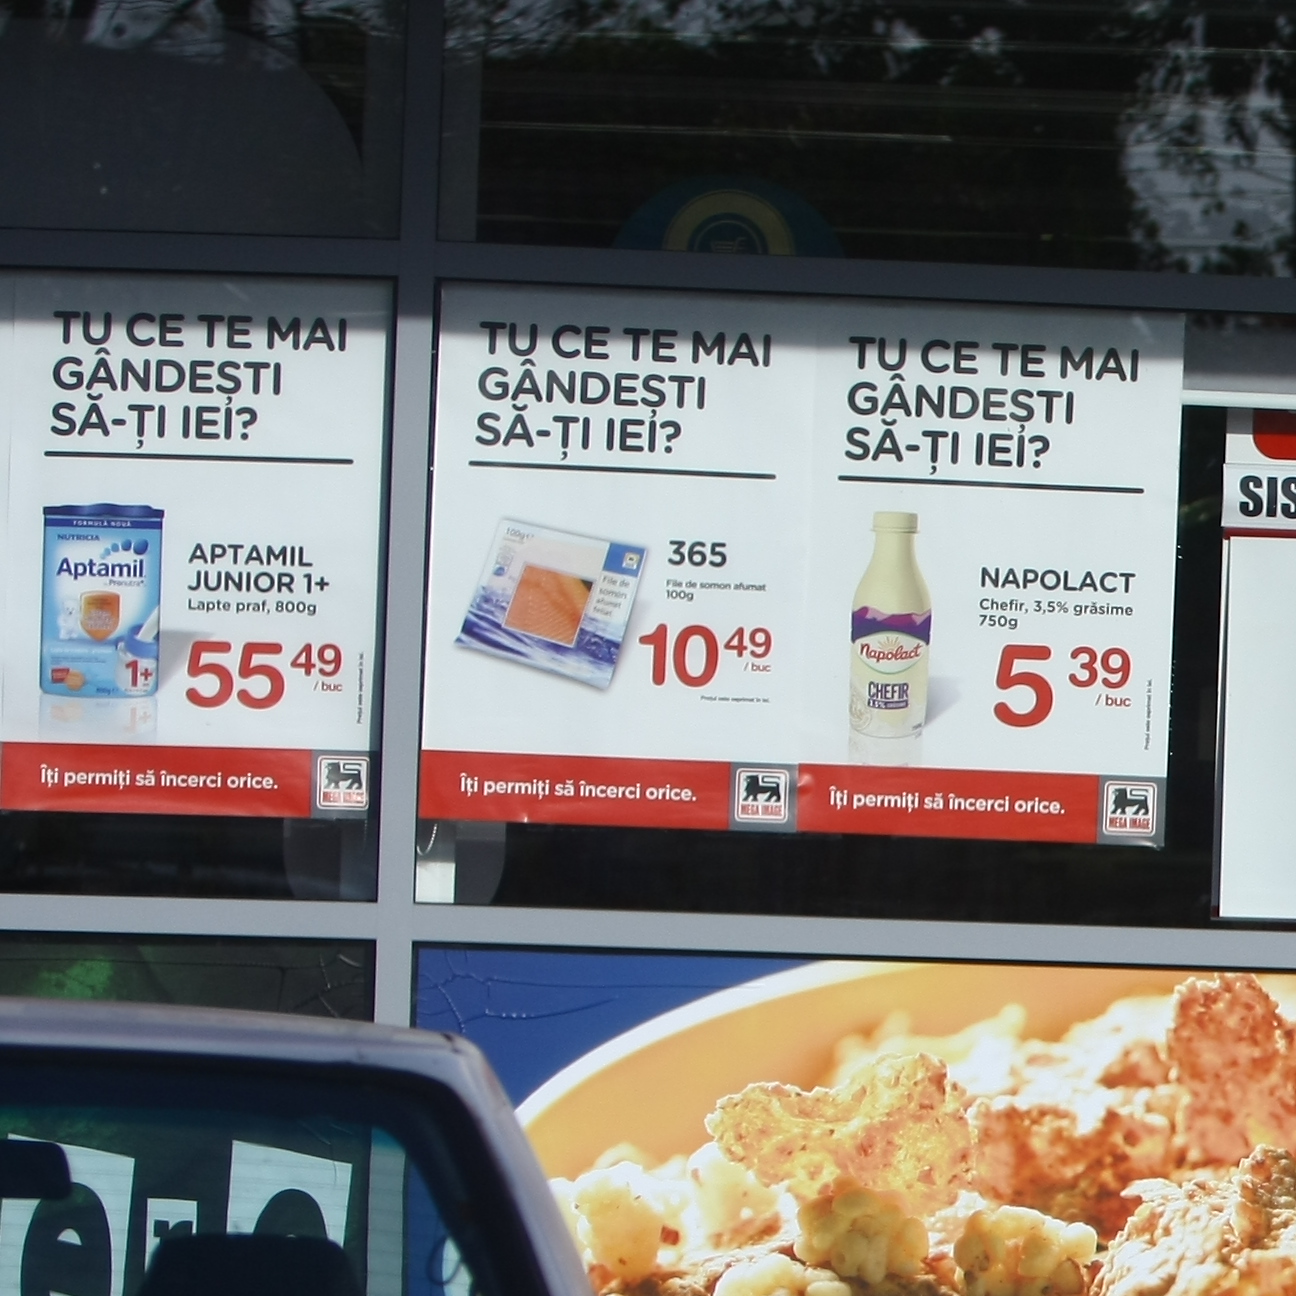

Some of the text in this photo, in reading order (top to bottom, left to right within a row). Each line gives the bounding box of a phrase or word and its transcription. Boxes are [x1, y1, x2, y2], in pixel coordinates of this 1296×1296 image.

[53, 310, 347, 352] TU CE TE MAI
[480, 320, 772, 367] TU CE TE MAI
[849, 336, 1139, 382] TU CE TE MAI
[52, 347, 282, 402] GÂNDEȘTI
[479, 361, 706, 416] GÂNDEȘTI
[848, 374, 1074, 430] GÂNDEȘTI
[50, 393, 258, 449] SĂ-ȚI IEI?
[476, 405, 682, 461] SĂ-ȚI IEI?
[846, 419, 1051, 475] SĂ-ȚI IEI?
[188, 542, 314, 567] APTAMIL
[668, 540, 727, 566] 365
[56, 557, 145, 580] Aptamil
[980, 568, 1136, 594] NAPOLACT
[188, 571, 330, 594] JUNIOR 1+
[666, 579, 766, 591] File de somon afumat
[666, 590, 694, 601] 100g
[187, 598, 318, 615] Lapte praf, 800g
[979, 598, 1133, 619] Chefir, 3,5% grăsime
[979, 616, 1018, 630] 750g
[639, 624, 772, 687] 10 49
[860, 643, 923, 662] Napolact
[125, 659, 153, 688] 1+
[185, 640, 343, 710] 55 49
[994, 644, 1131, 728] 5 39
[868, 681, 909, 699] CHEFIR
[63, 768, 132, 789] permiți
[135, 768, 156, 787] să
[160, 768, 222, 788] încerci
[226, 770, 278, 790] orice.
[483, 776, 550, 800] permiți
[555, 778, 575, 797] să
[579, 778, 641, 800] încerci
[646, 782, 697, 802] orice.
[852, 790, 920, 814] permiți
[923, 790, 944, 811] să
[948, 792, 1010, 814] încerci
[1014, 795, 1065, 816] orice.
